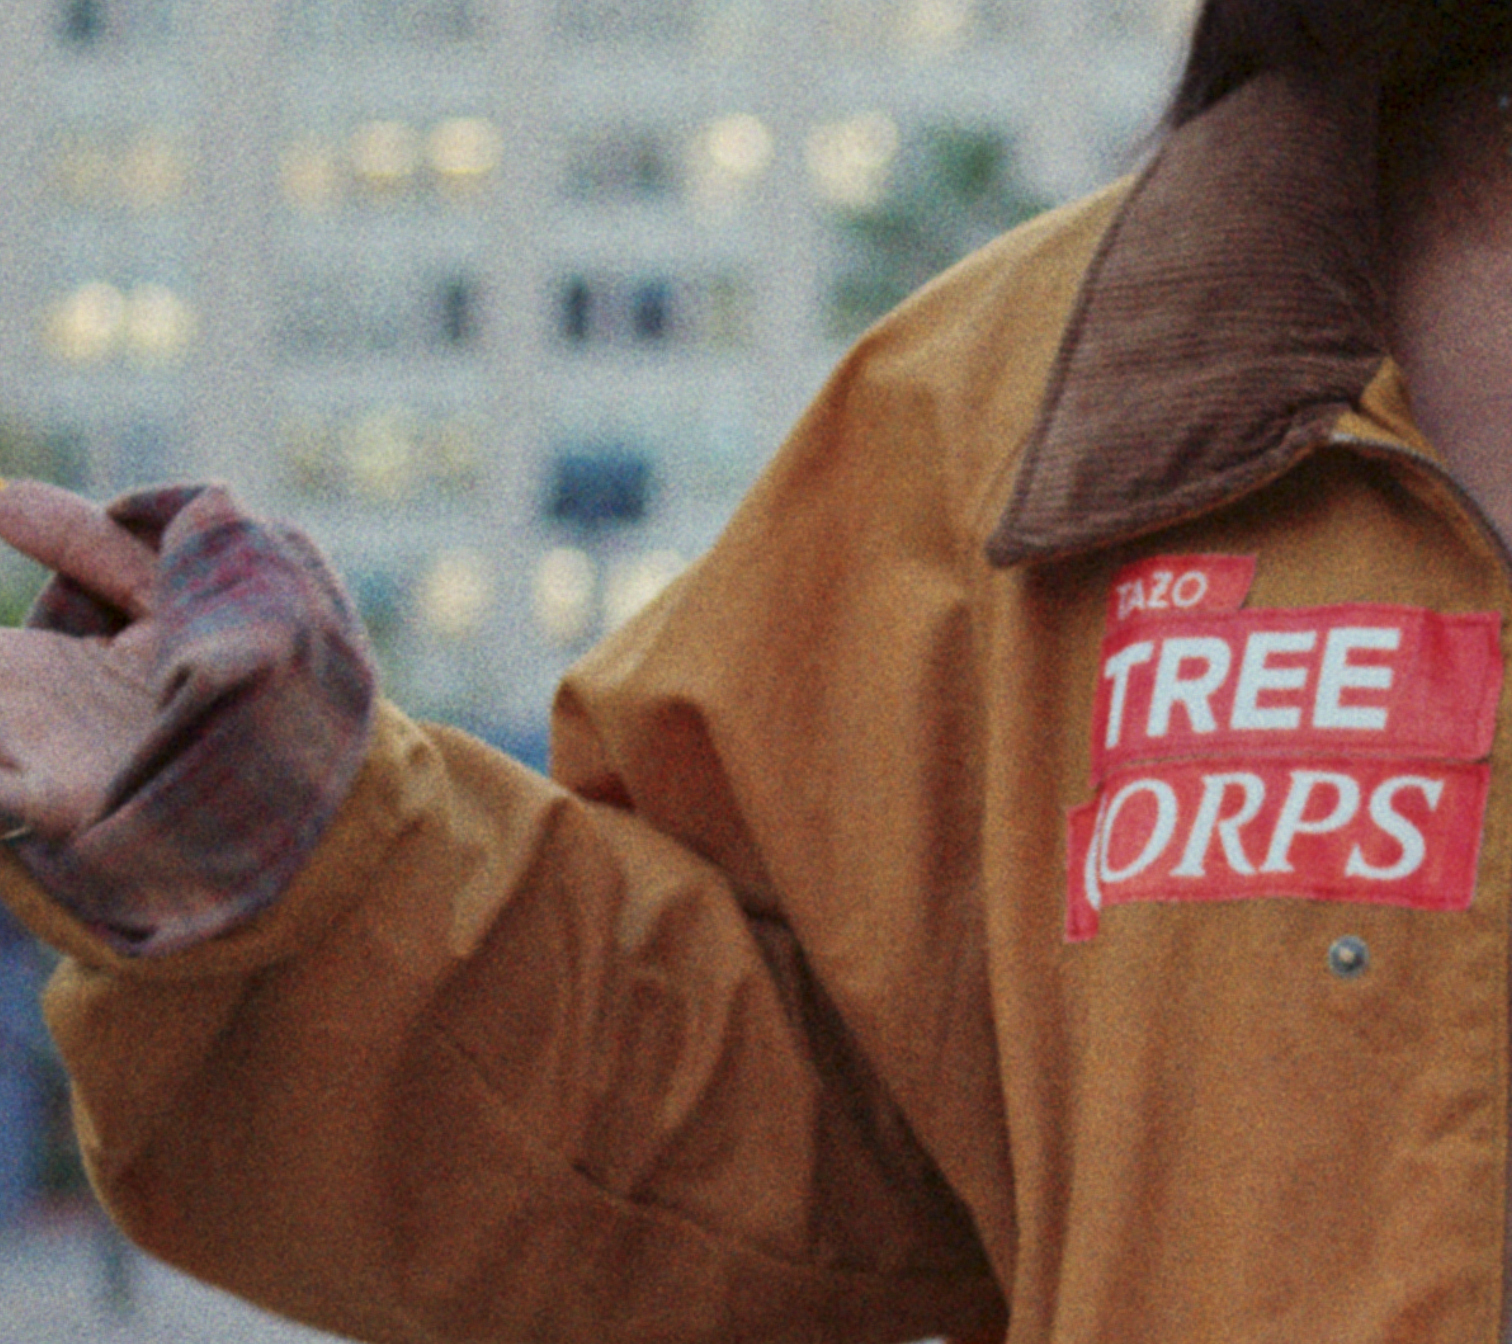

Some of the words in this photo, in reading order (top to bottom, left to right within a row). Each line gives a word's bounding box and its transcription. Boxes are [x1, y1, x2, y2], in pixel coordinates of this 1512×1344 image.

[1116, 570, 1208, 620] TAZO
[1103, 626, 1401, 749] TREE
[1084, 769, 1445, 910] ORPS
